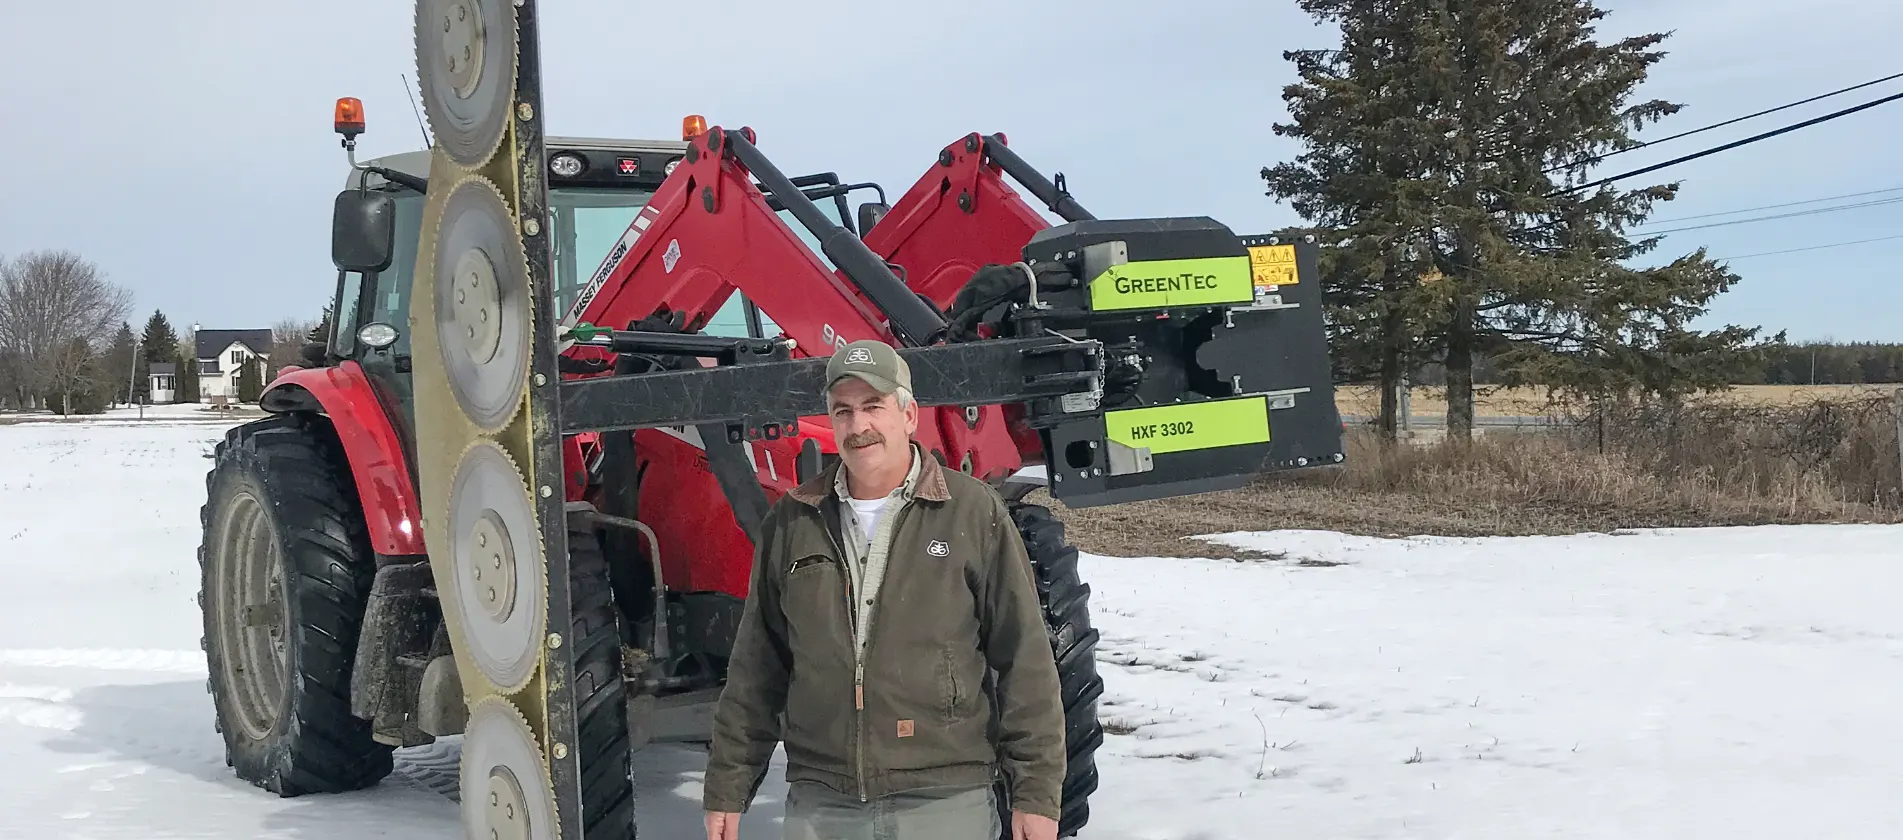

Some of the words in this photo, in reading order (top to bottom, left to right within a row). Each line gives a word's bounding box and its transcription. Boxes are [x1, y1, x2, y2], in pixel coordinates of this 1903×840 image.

[573, 281, 597, 319] MASSEY
[595, 240, 628, 288] FERGUSON
[1131, 424, 1157, 440] HXF
[1160, 421, 1194, 437] 3302
